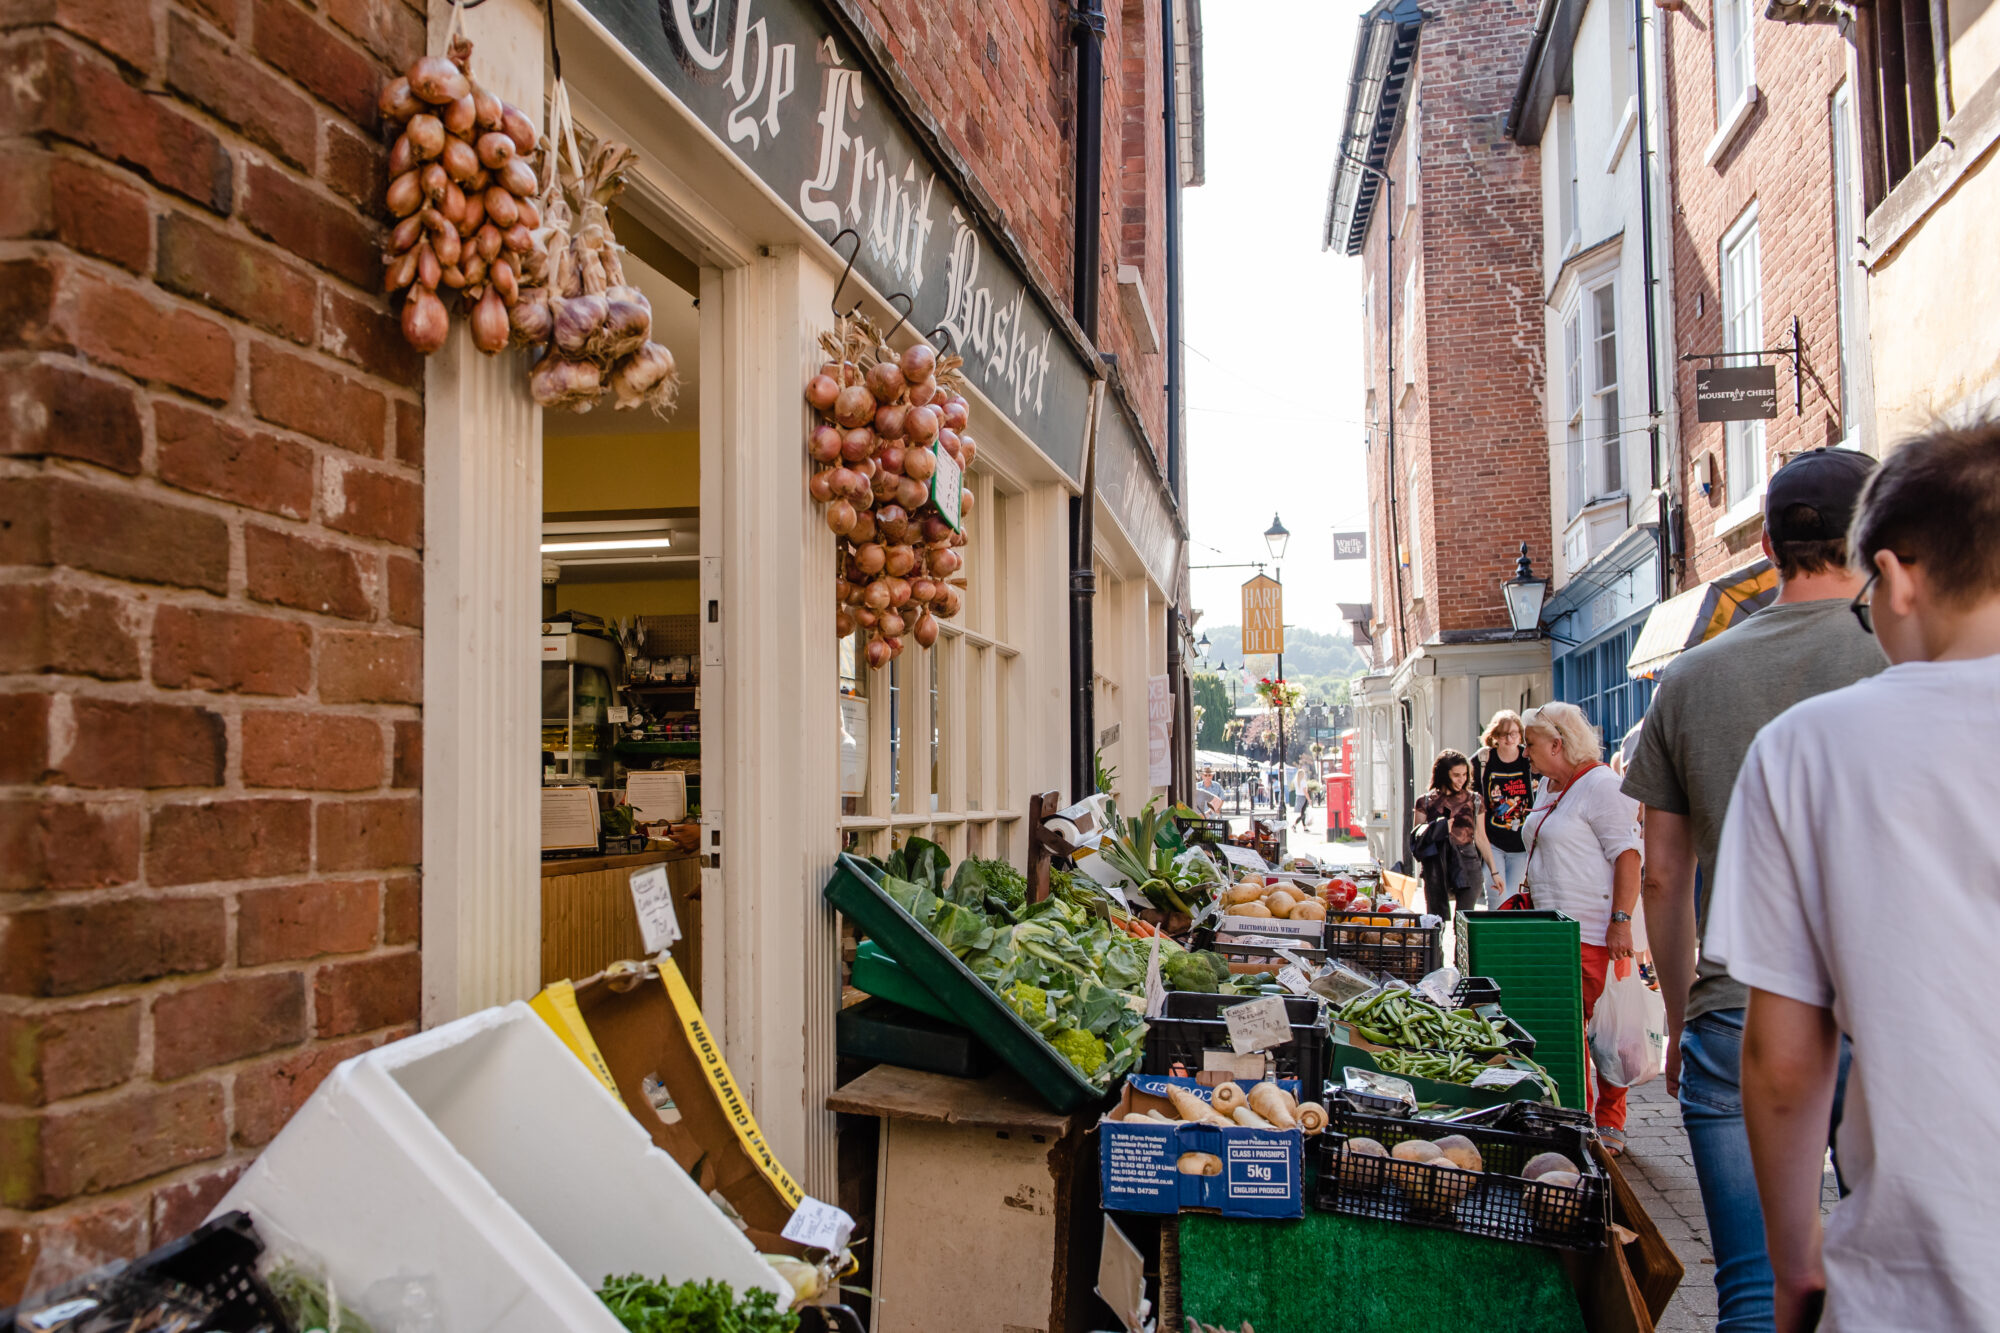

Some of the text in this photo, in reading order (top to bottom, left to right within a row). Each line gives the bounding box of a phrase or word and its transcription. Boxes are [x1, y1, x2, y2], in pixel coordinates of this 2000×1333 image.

[670, 0, 1053, 416] The Fruit Basket
[1698, 381, 1710, 390] The
[1699, 389, 1775, 401] MOUSETRAP CHEESE
[1761, 398, 1775, 412] Shop
[1244, 587, 1281, 609] HARP
[1244, 608, 1281, 630] LANE
[1245, 629, 1282, 652] DELI.
[689, 1020, 718, 1065] CORN
[712, 1066, 749, 1126] CULVER
[1149, 1142, 1163, 1150] Farm
[1231, 1150, 1252, 1158] CLASS
[1255, 1150, 1286, 1159] PARSNIPS
[1247, 1164, 1272, 1181] 5kg
[1233, 1186, 1286, 1195] ENGLISH PRODUCE
